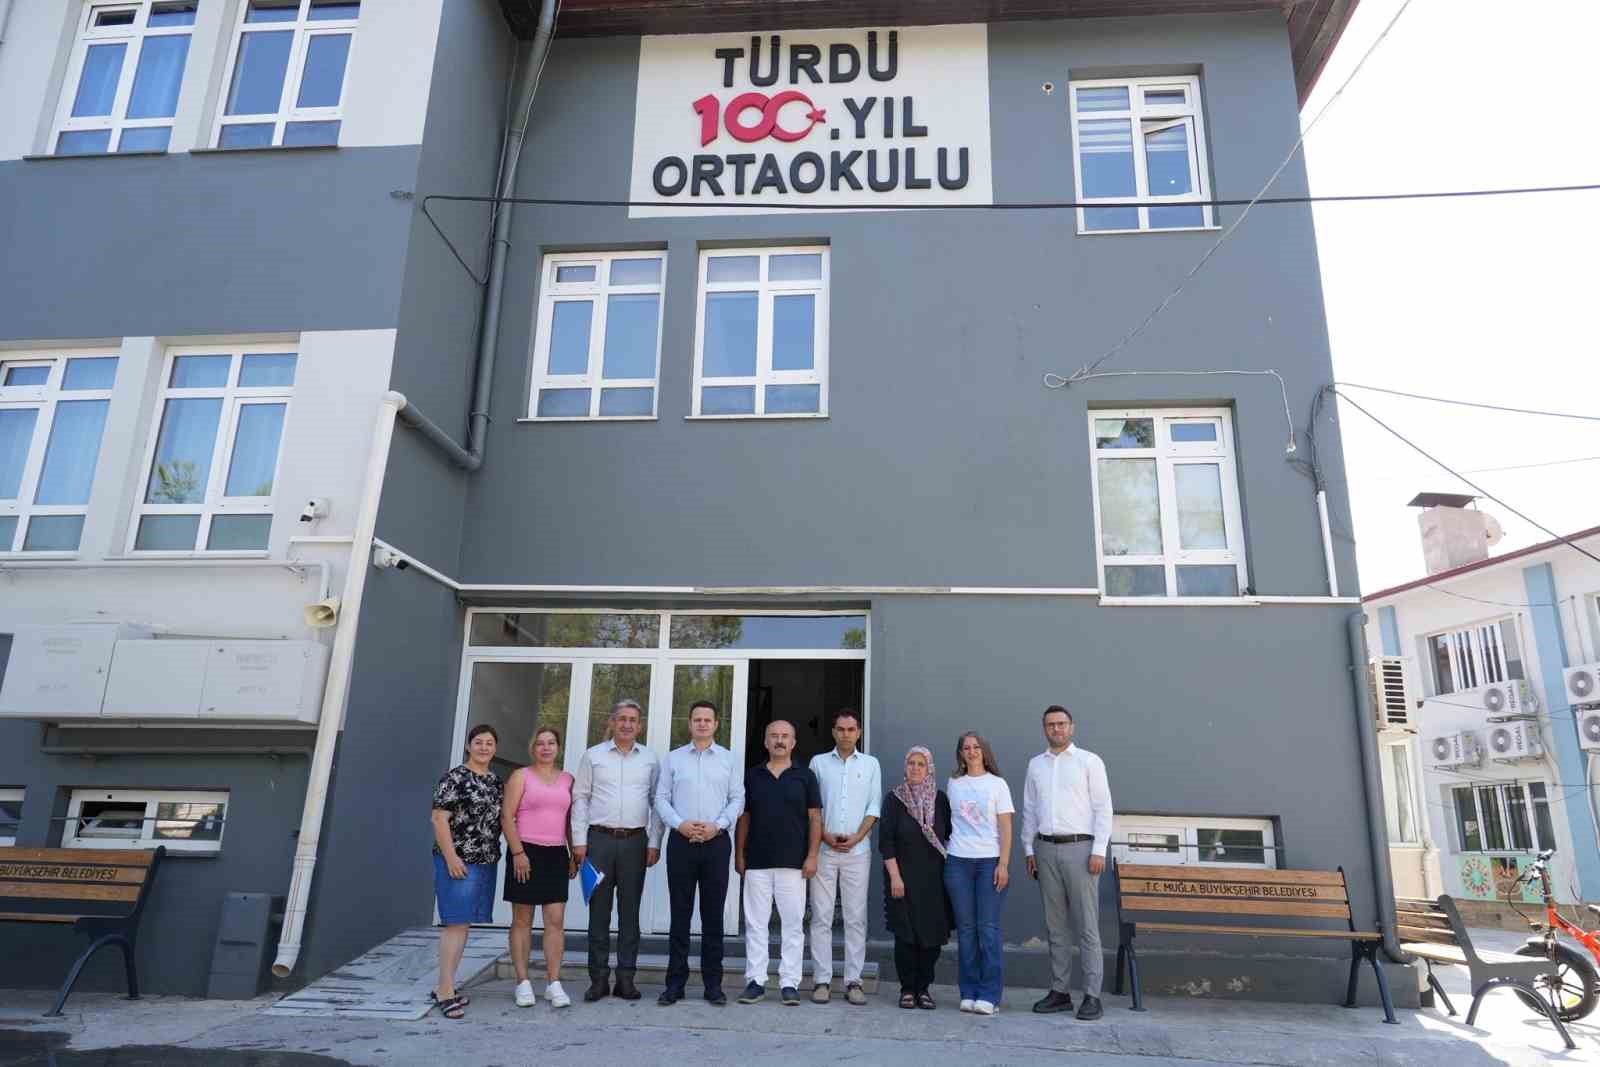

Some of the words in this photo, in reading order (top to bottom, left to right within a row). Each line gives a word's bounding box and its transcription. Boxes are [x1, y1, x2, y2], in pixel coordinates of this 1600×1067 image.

[715, 31, 899, 88] TÜRDÜ
[652, 146, 969, 197] ORTAOKULU
[1164, 880, 1197, 893] MUĞLA
